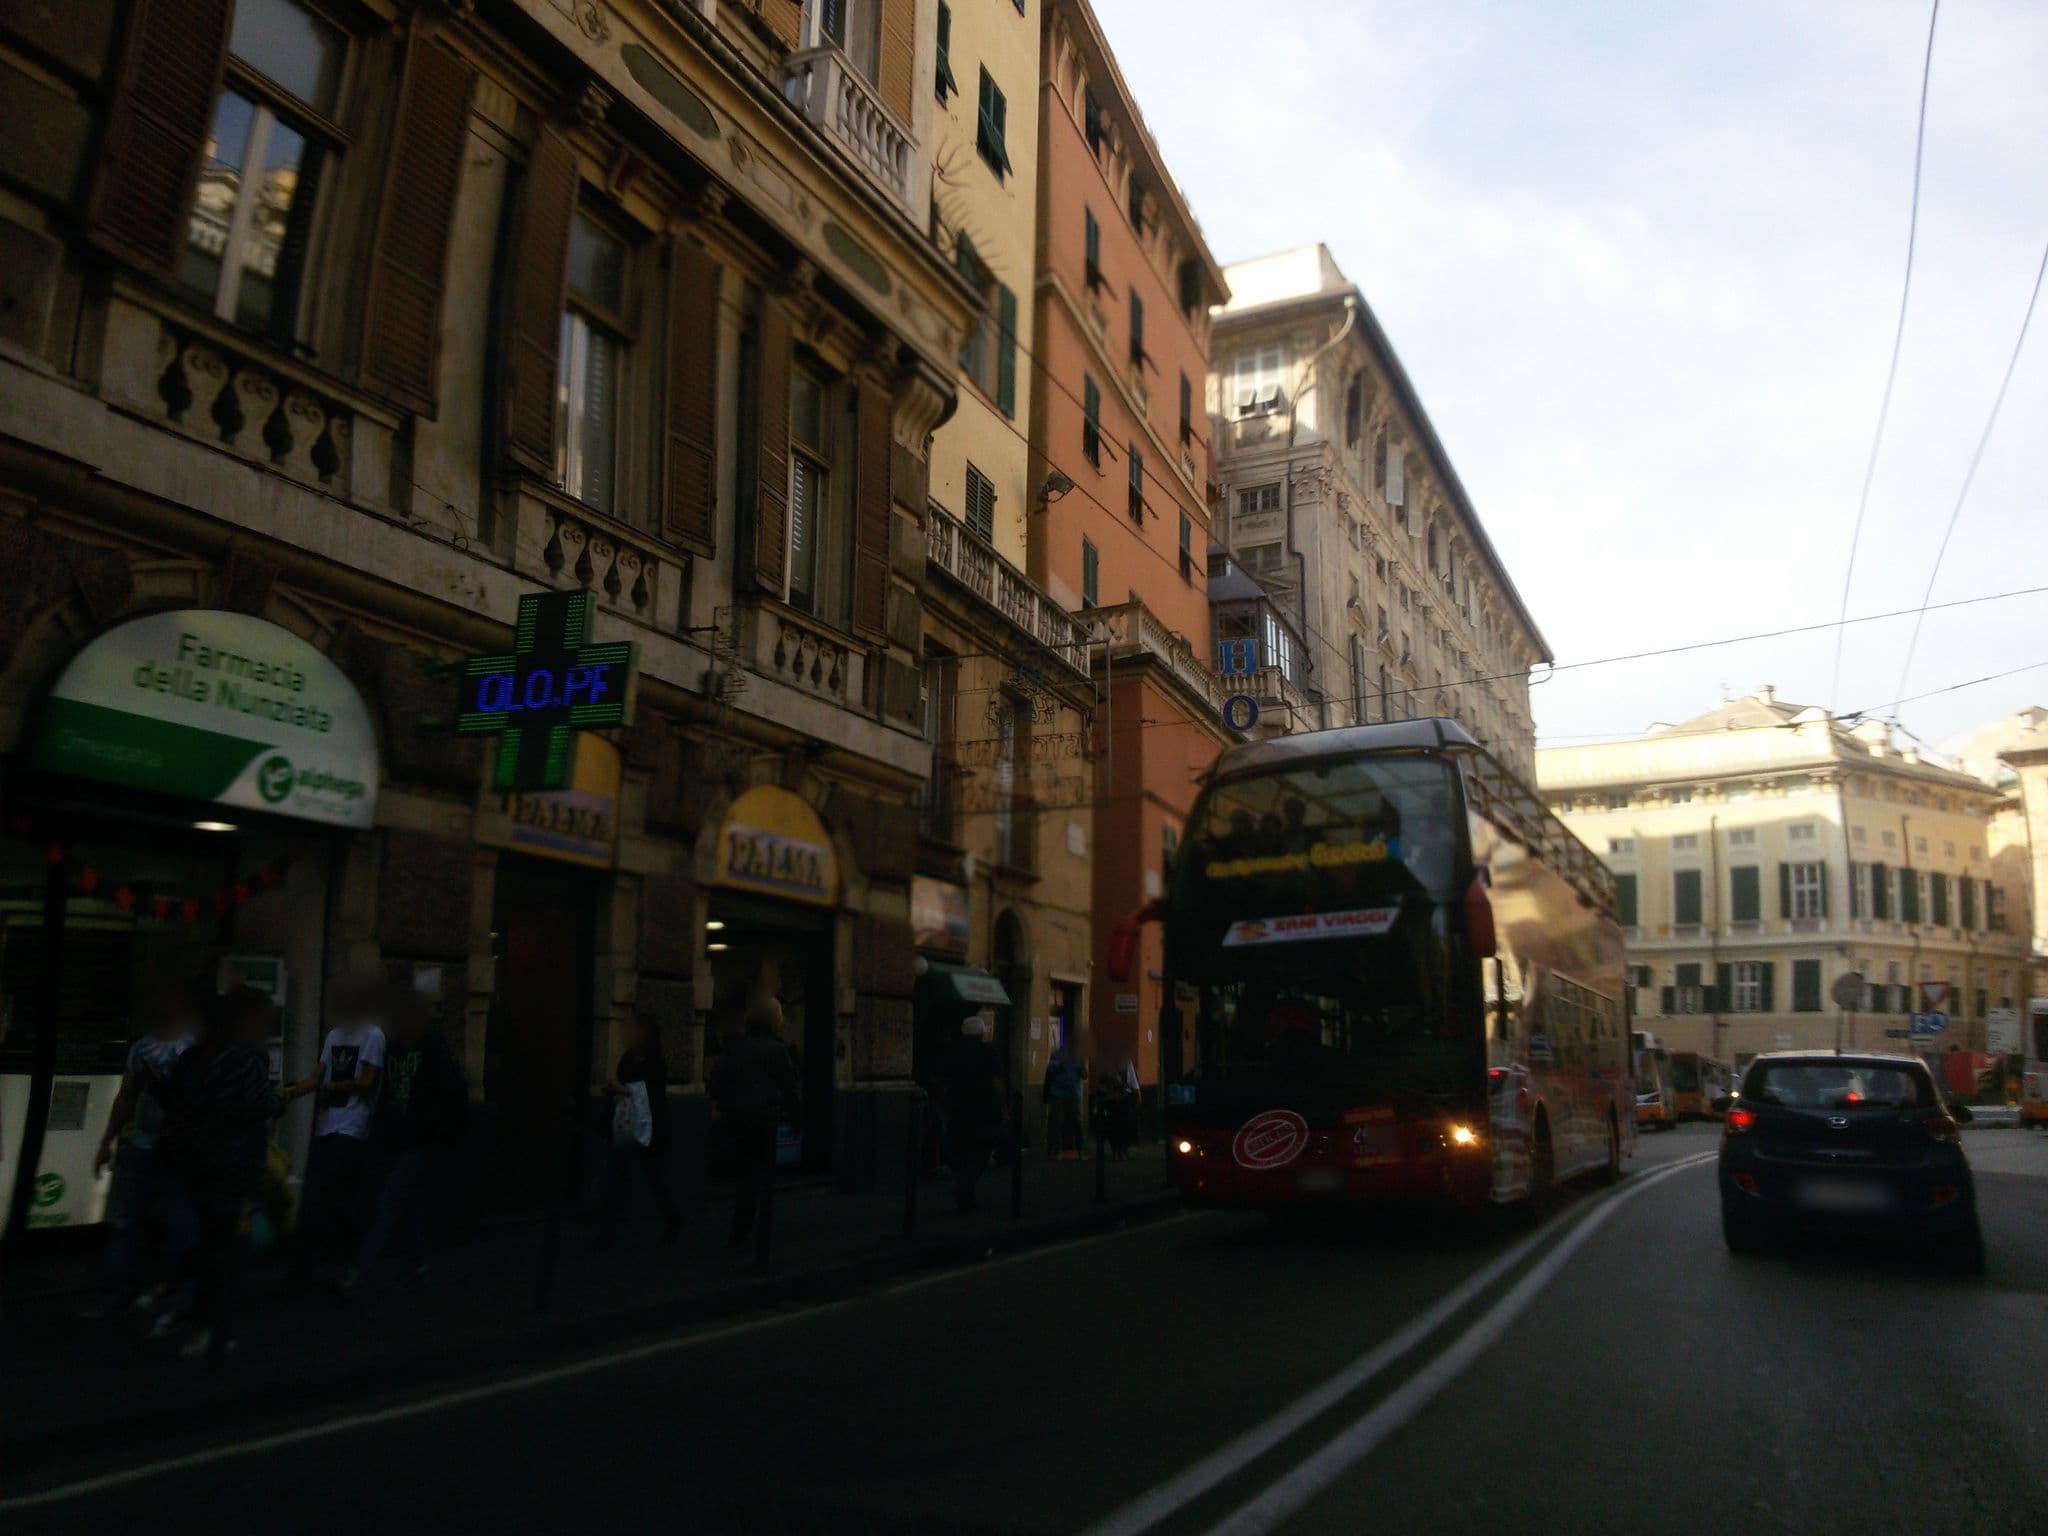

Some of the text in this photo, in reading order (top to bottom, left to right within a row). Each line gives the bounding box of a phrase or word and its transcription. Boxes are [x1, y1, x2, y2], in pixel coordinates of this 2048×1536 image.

[176, 632, 305, 692] Farmacia
[133, 660, 333, 733] della Nunziata
